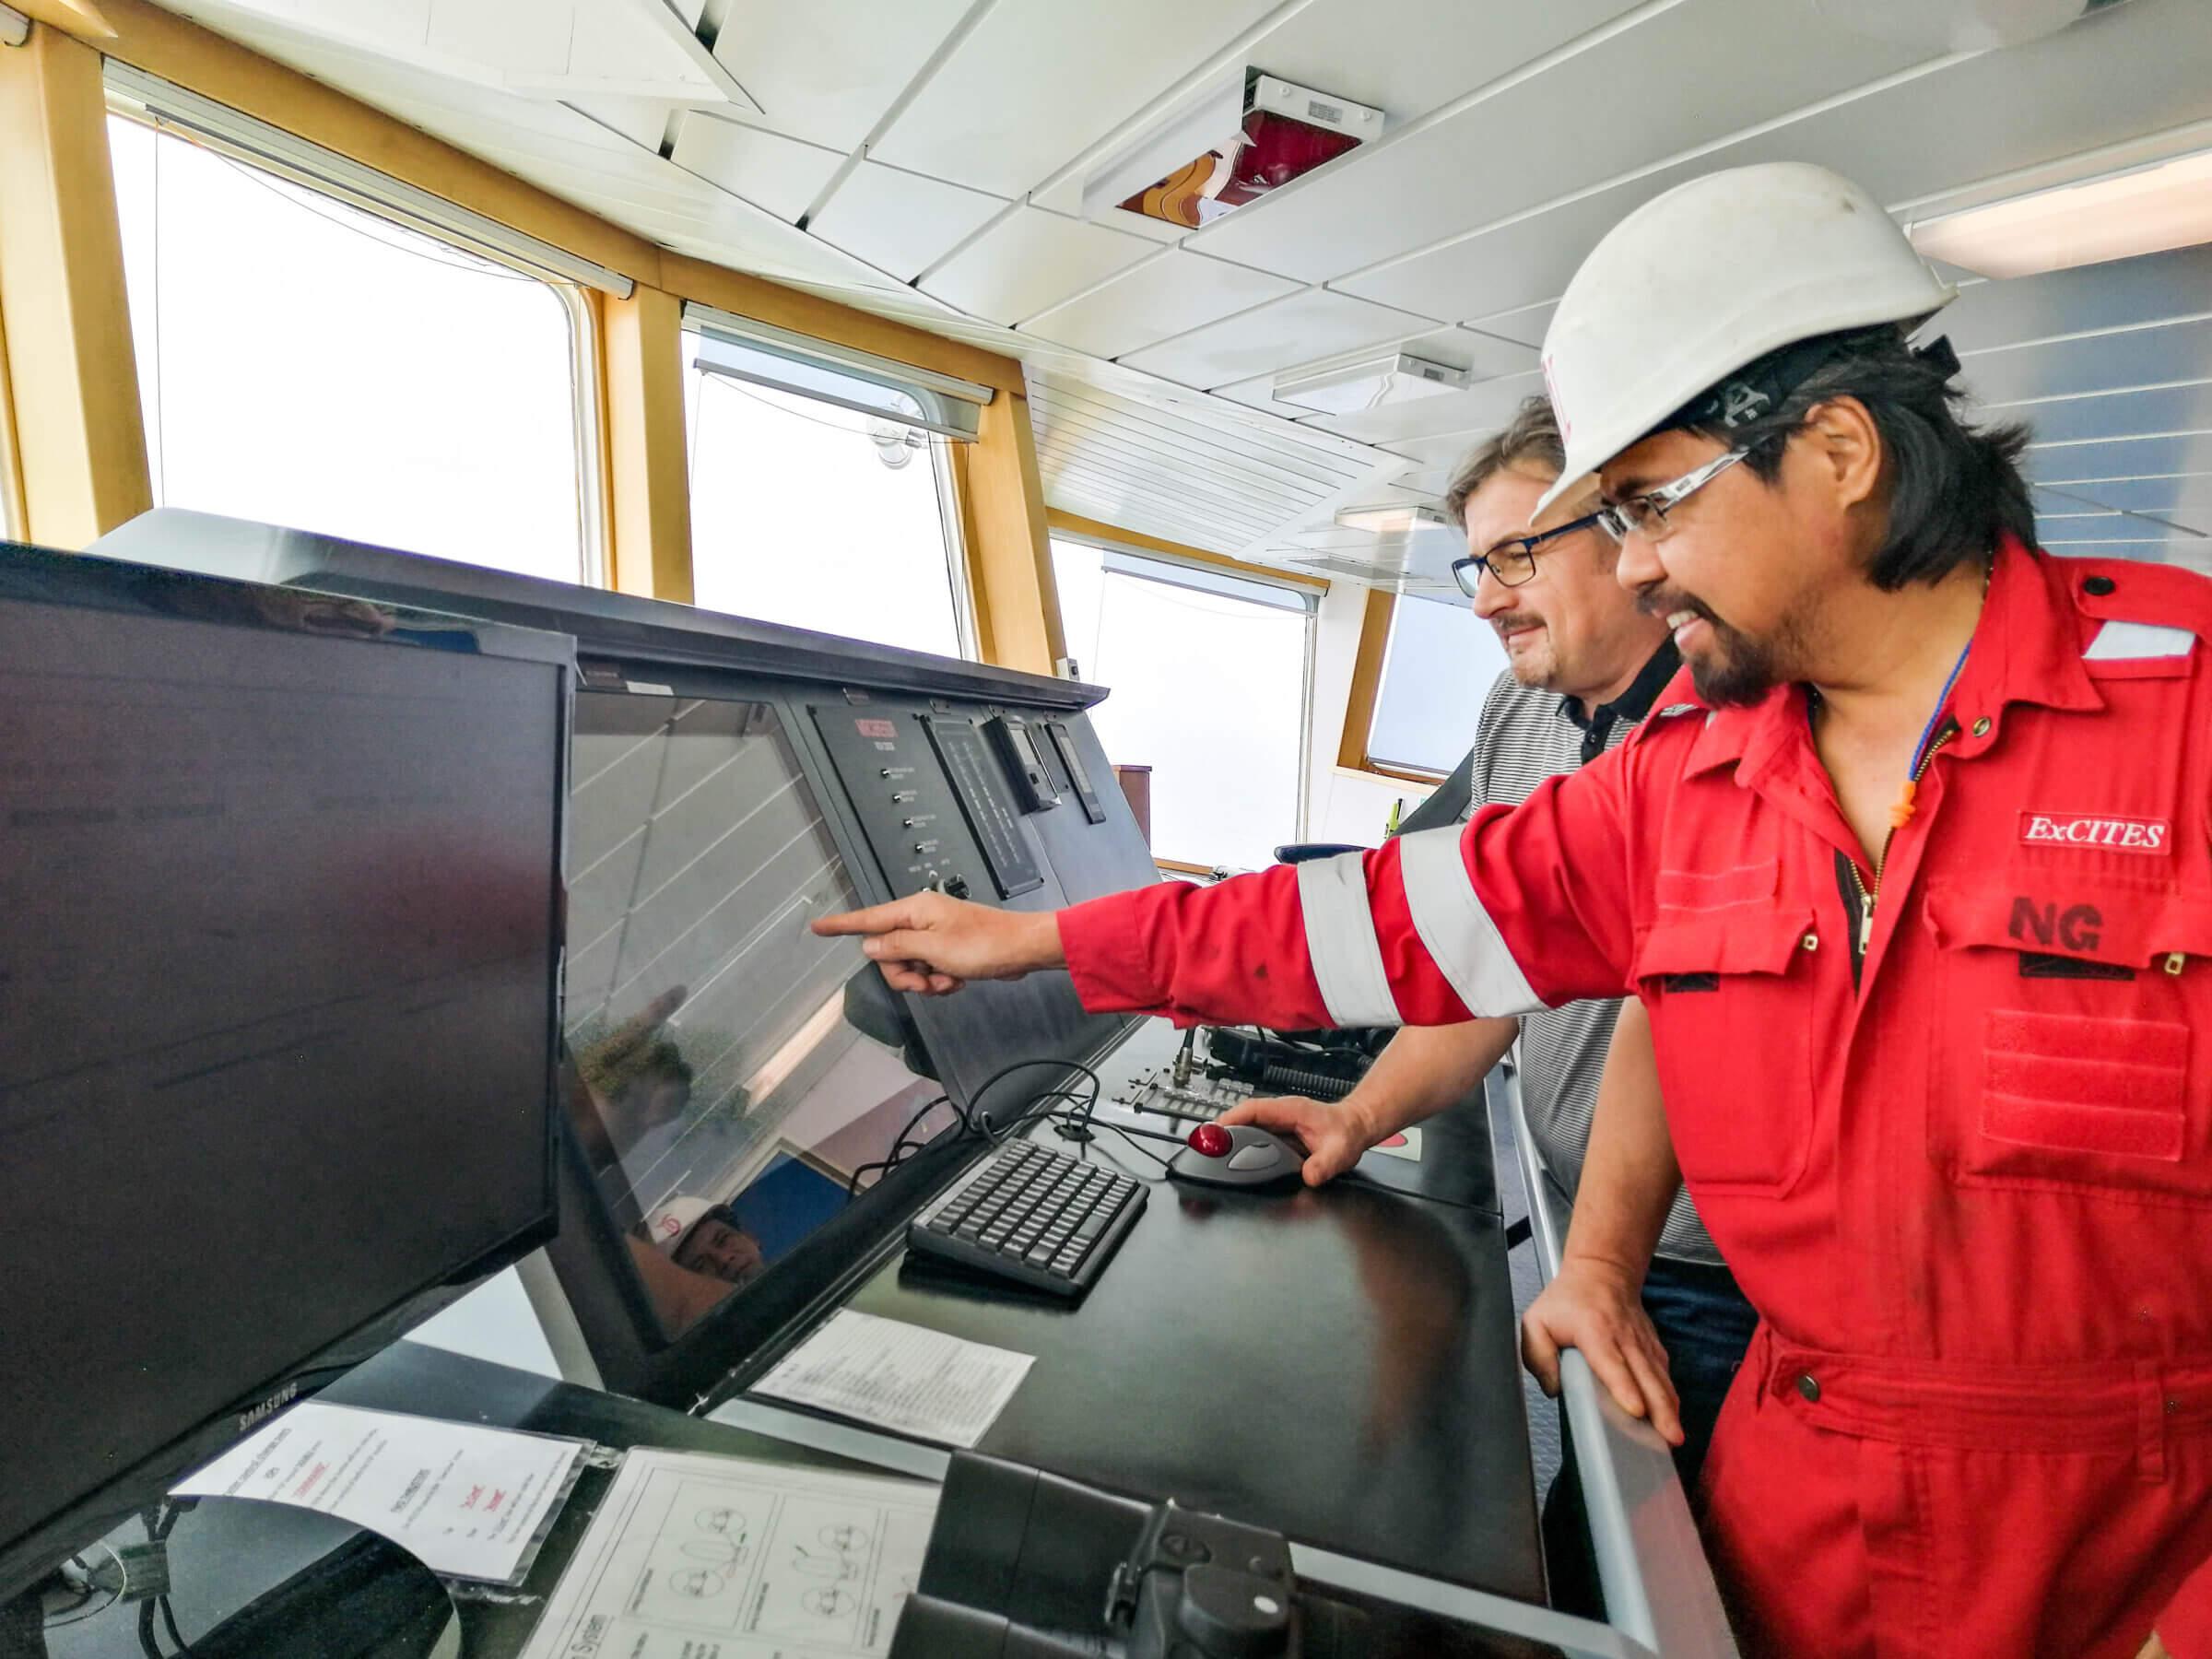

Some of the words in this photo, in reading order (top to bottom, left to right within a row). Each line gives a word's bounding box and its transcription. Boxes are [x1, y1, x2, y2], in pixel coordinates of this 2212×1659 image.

[2025, 817, 2164, 848] ExCITES
[2007, 896, 2104, 952] NG
[239, 1382, 298, 1431] SAMSUNG
